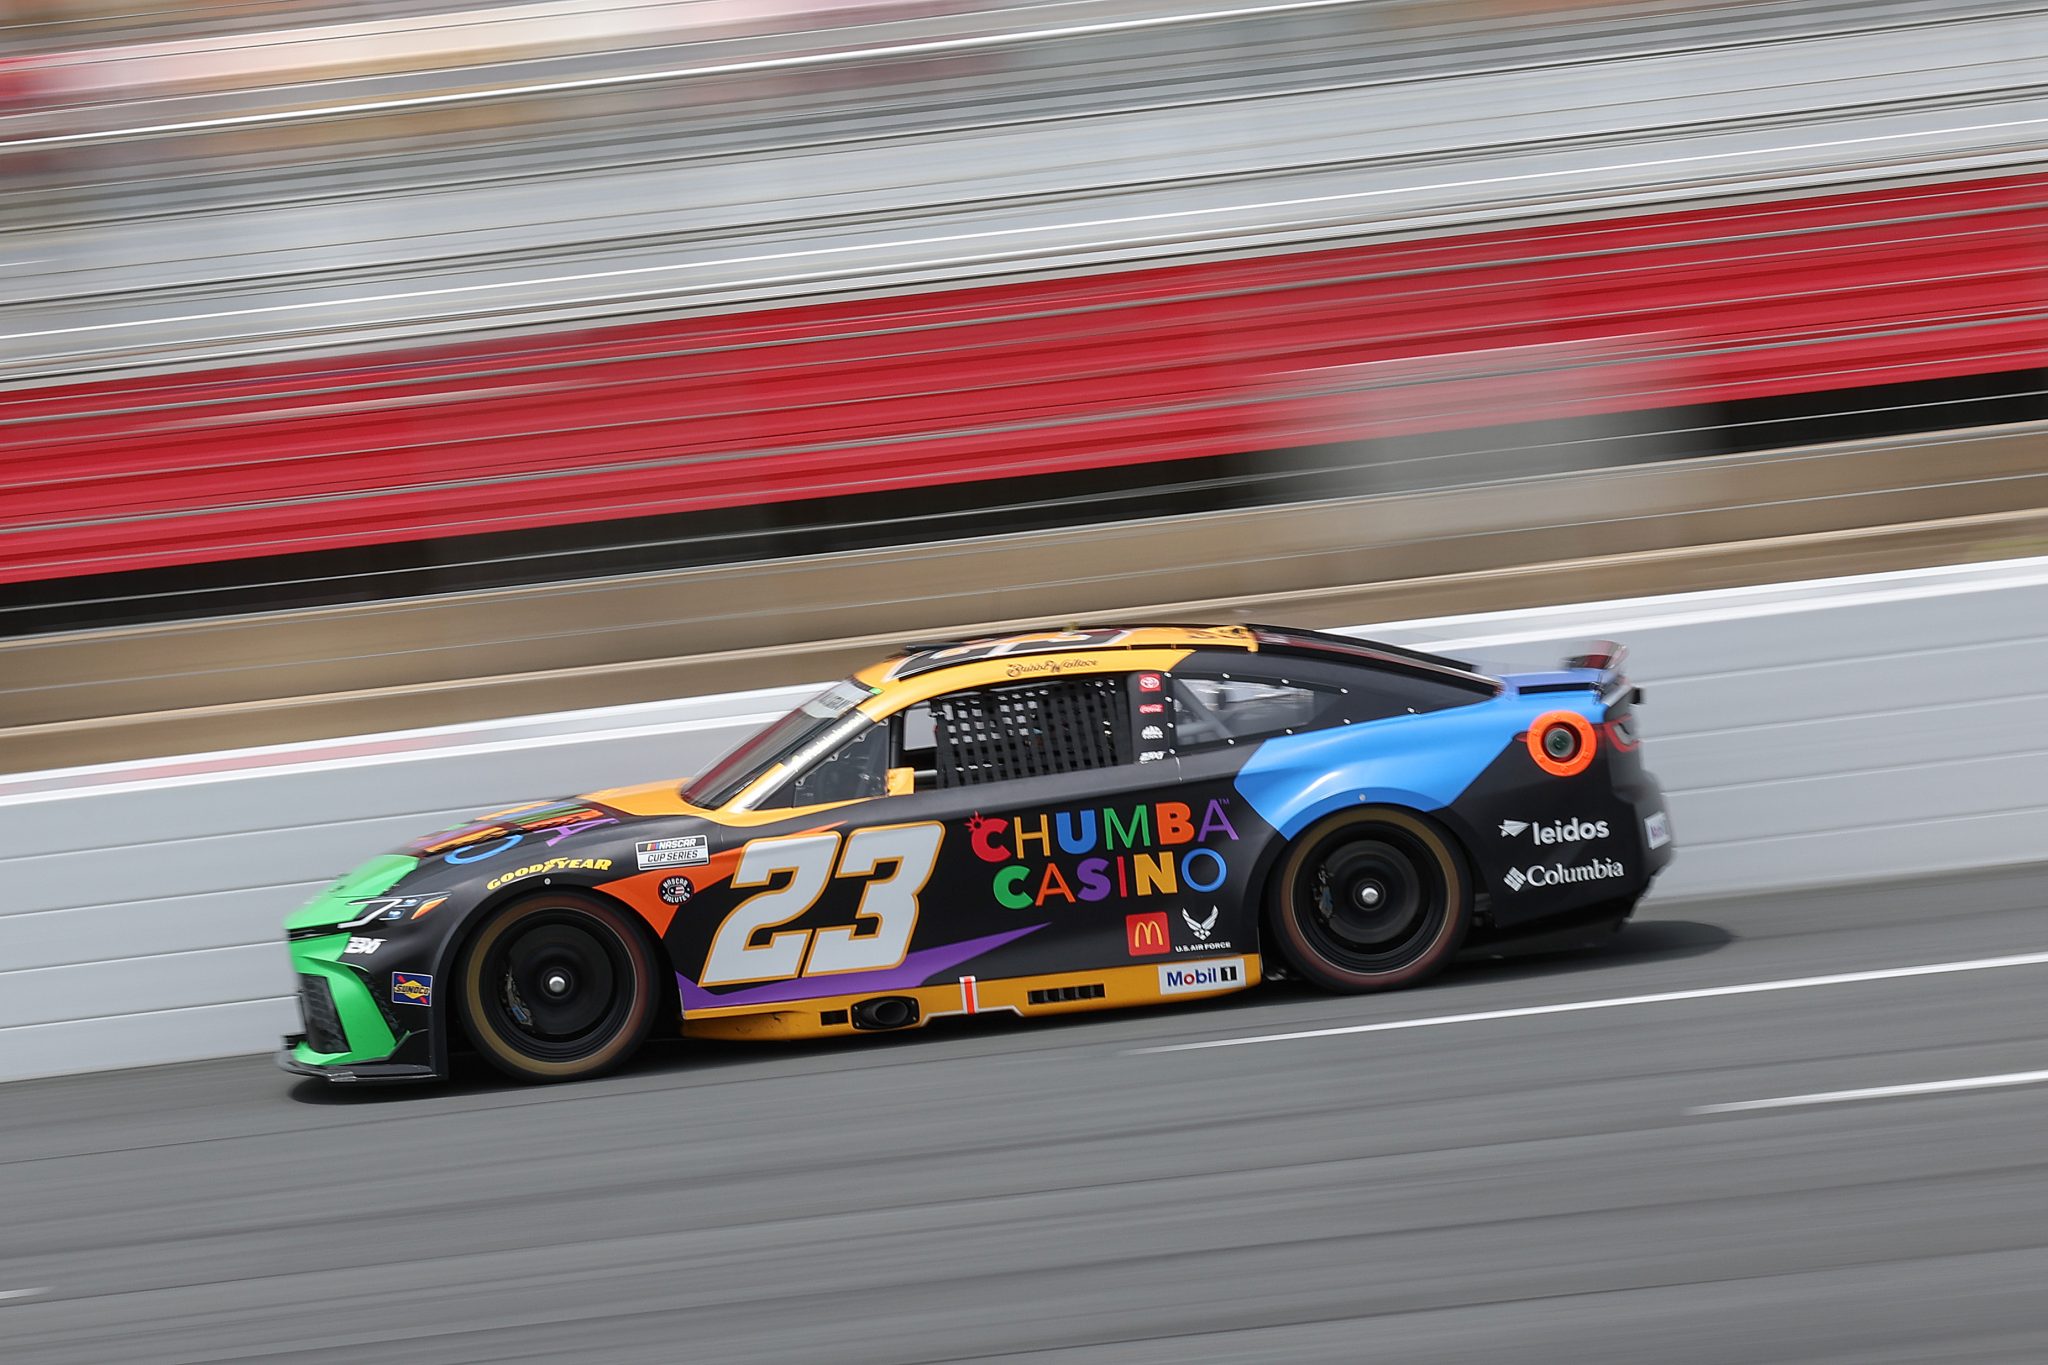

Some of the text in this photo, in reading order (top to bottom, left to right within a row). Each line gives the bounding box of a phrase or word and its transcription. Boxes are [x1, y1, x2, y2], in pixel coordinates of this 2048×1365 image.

[966, 799, 1239, 863] CHUMBA
[1531, 816, 1610, 846] leidos
[658, 838, 697, 850] NASCAR
[647, 850, 698, 863] CUP SERIES
[486, 857, 613, 890] GOODYEAR
[993, 847, 1228, 910] CASINO
[1525, 857, 1625, 888] Columbia
[662, 877, 689, 889] NASCAR
[662, 891, 691, 904] SALUTES
[697, 820, 946, 987] 23
[1190, 943, 1204, 952] AIR
[1204, 942, 1231, 950] FORCE
[1166, 967, 1217, 987] Mobil
[395, 984, 430, 995] SUNOCO
